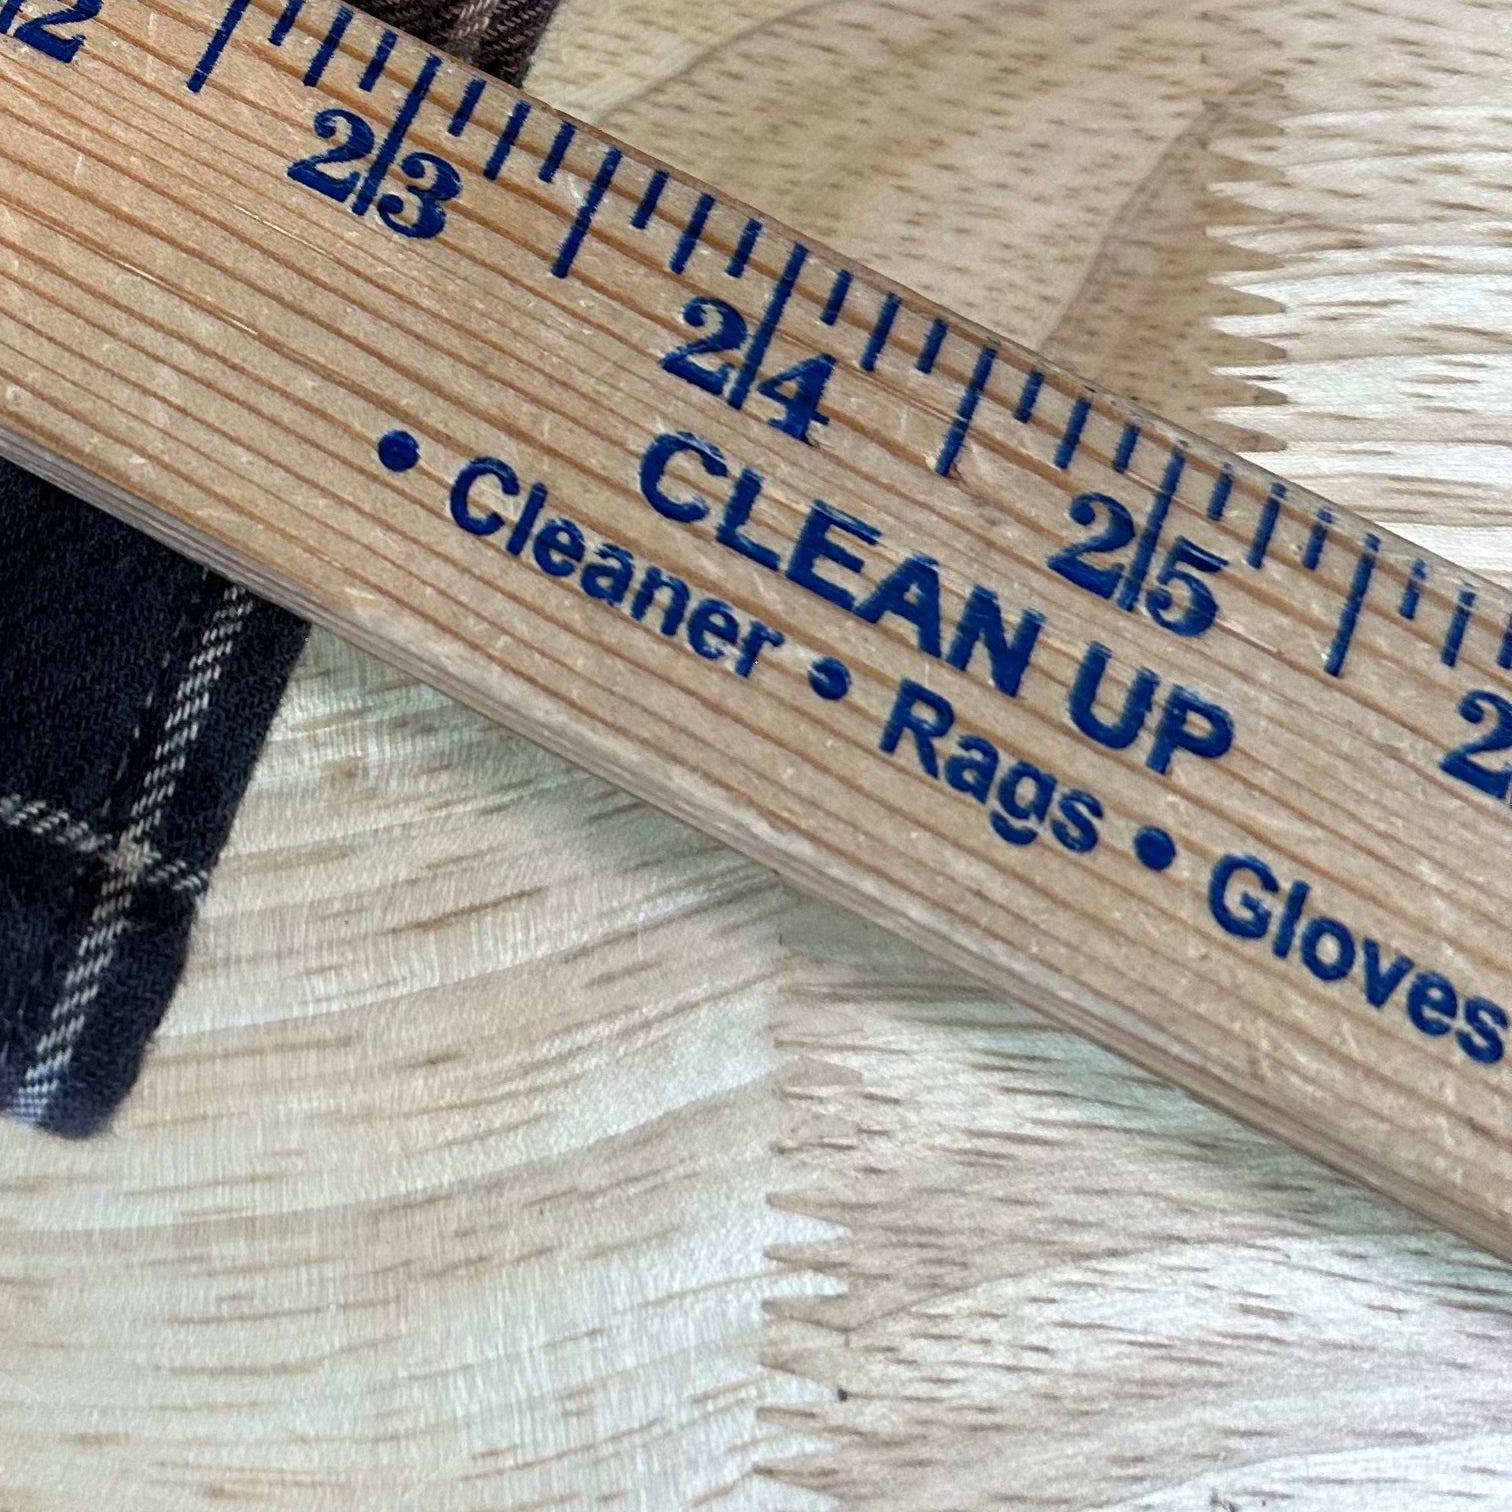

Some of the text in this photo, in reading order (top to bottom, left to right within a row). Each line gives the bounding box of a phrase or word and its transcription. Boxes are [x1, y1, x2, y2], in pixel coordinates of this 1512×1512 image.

[286, 108, 462, 239] 23
[660, 296, 837, 445] 24
[638, 432, 1235, 774] CLEAN UP
[1047, 491, 1229, 637] 25
[448, 456, 1509, 1065] Cleaner Rags Gloves
[1439, 689, 1512, 800] 2
